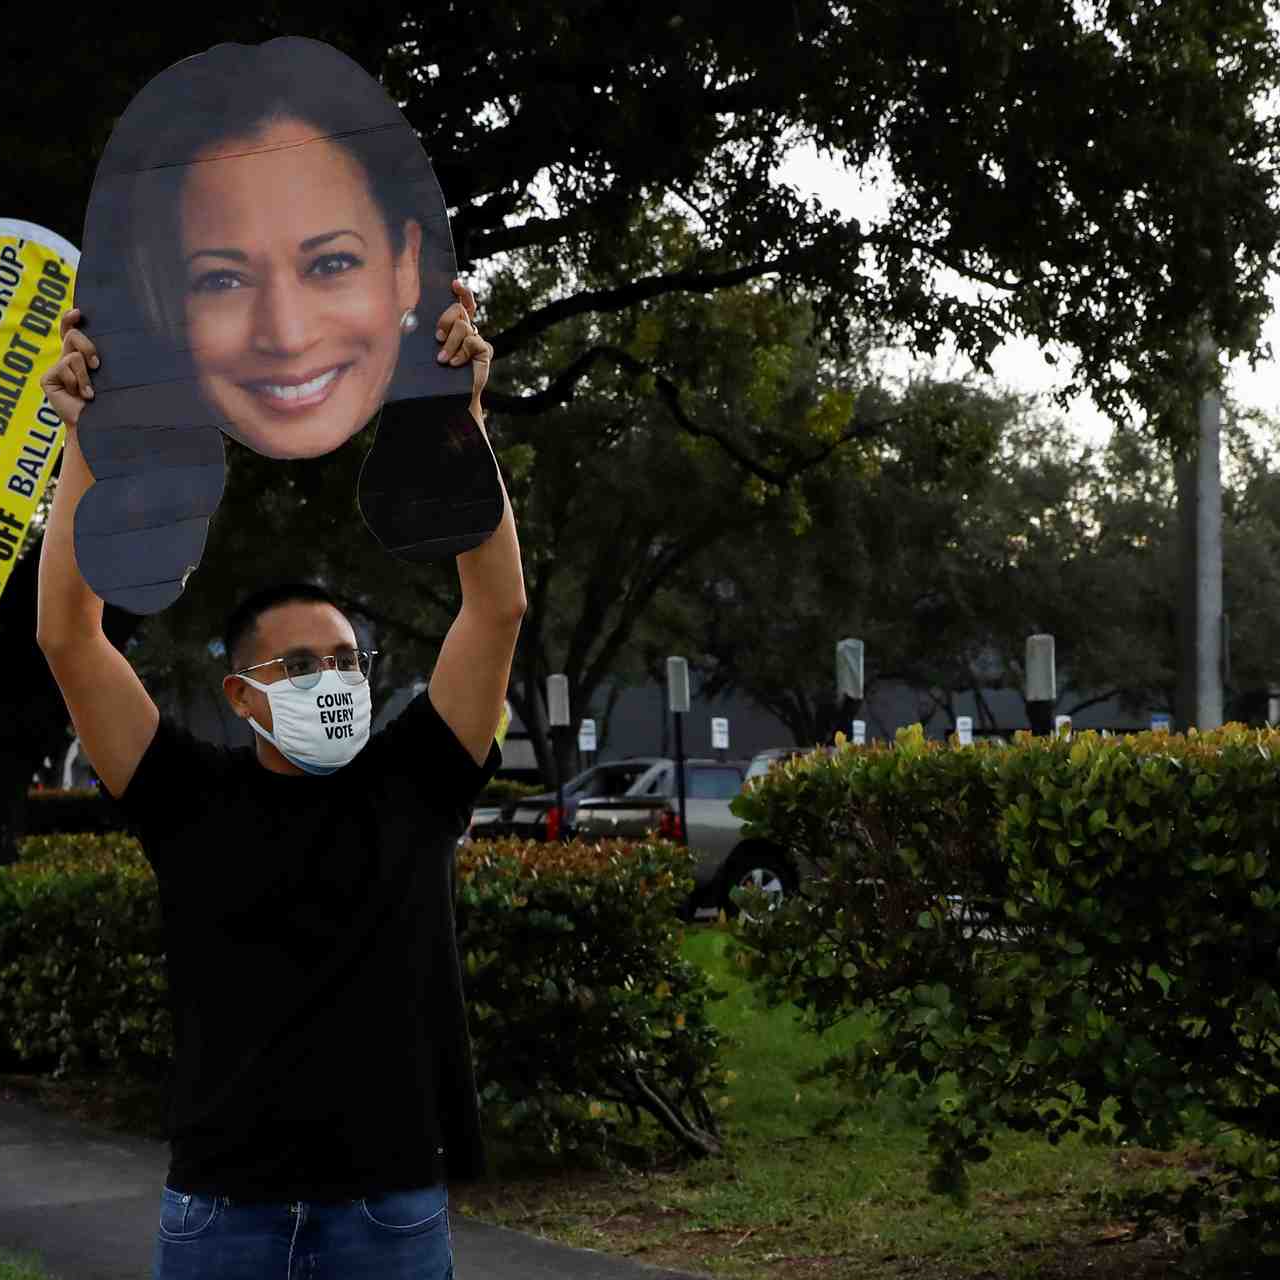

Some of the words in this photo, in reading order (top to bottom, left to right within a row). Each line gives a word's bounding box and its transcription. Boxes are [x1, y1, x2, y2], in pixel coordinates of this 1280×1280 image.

[8, 398, 64, 498] BALLO
[316, 692, 354, 709] COUNT
[320, 707, 354, 724] EVERY
[325, 723, 354, 740] VOTE
